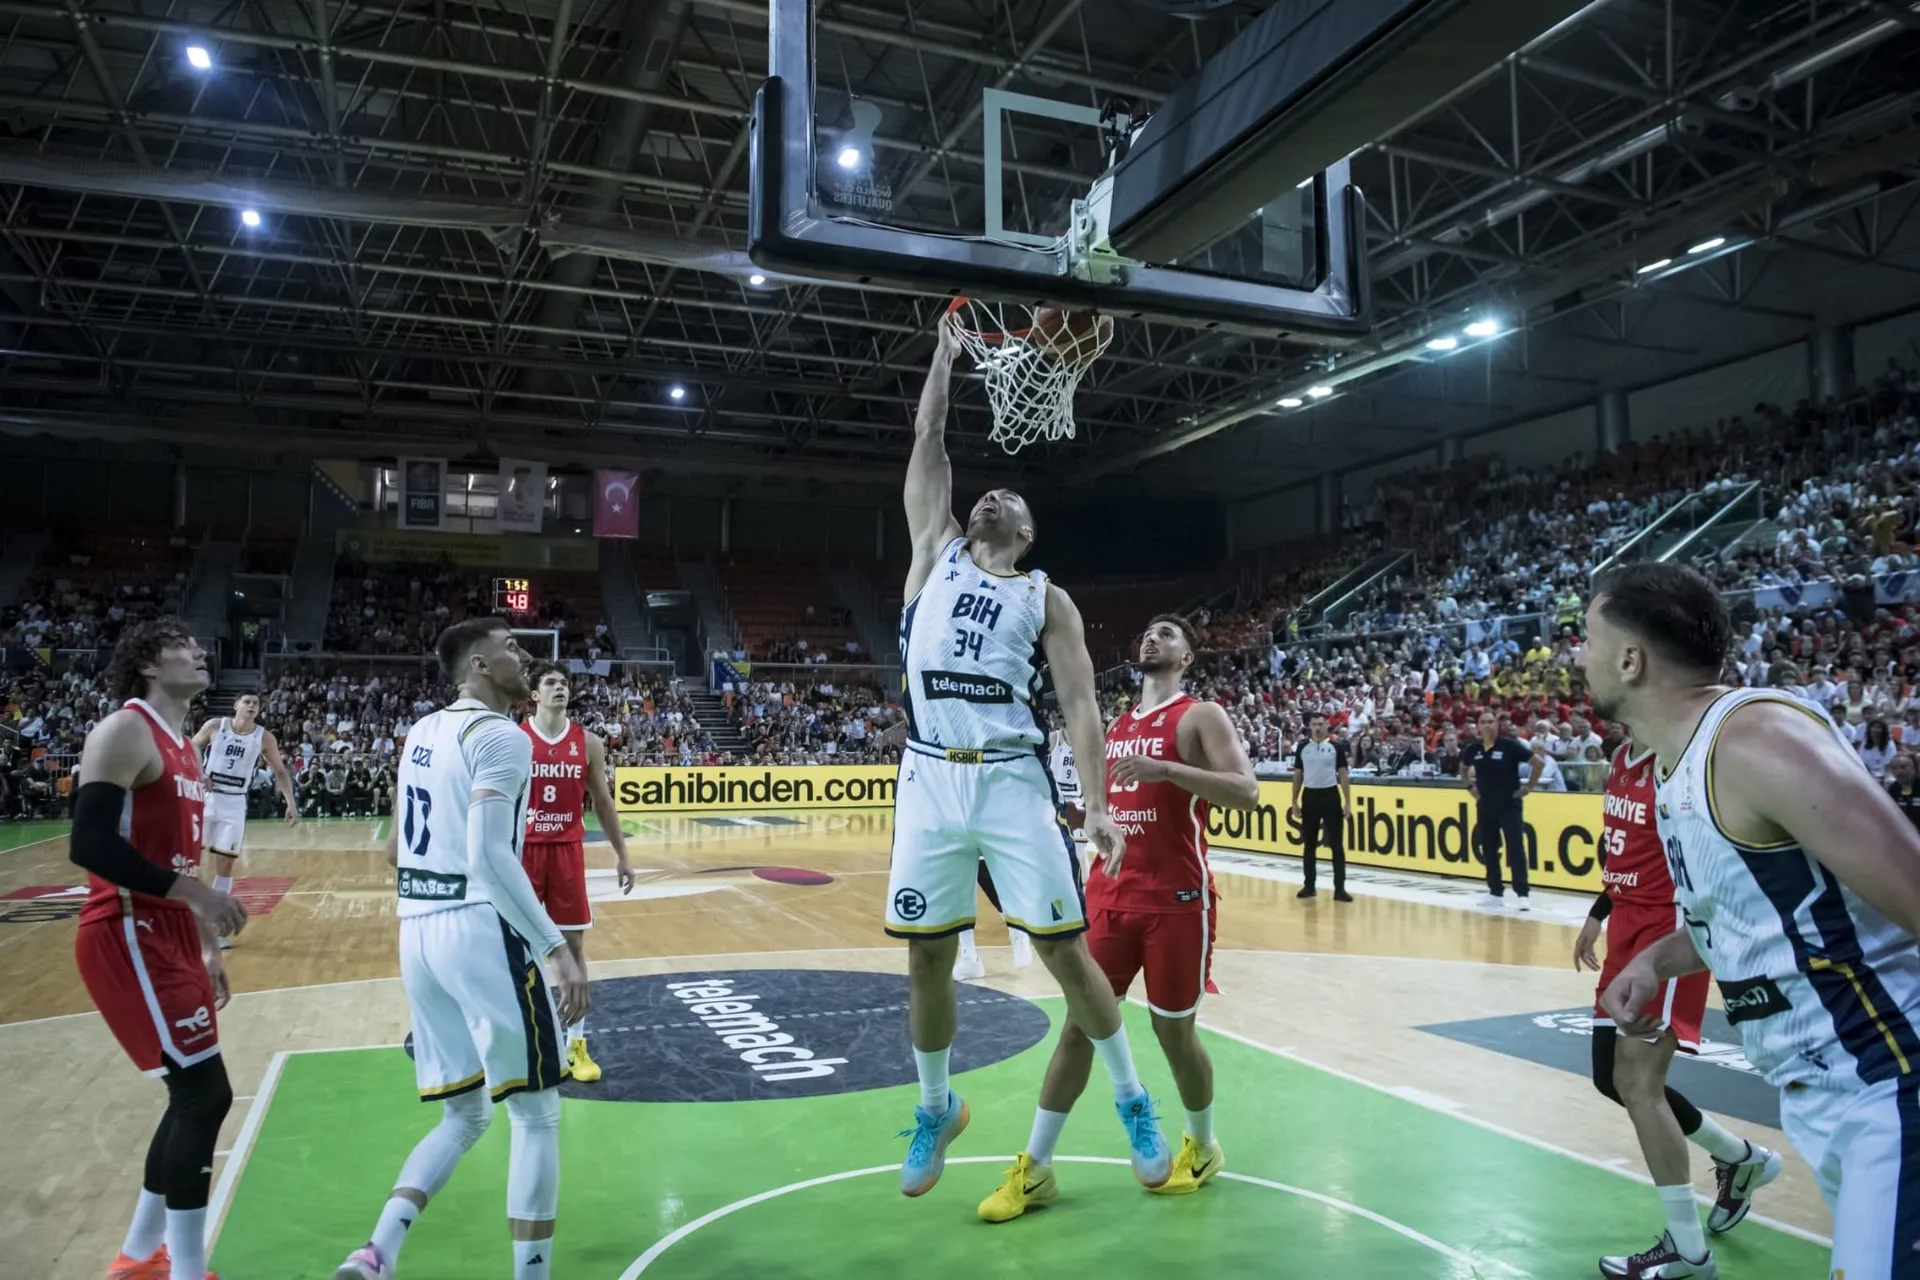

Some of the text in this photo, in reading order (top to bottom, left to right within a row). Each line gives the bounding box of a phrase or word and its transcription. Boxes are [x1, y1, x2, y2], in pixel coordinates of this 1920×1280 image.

[410, 498, 434, 509] FIBA
[951, 593, 1003, 632] BIH
[953, 628, 983, 662] 34
[932, 677, 1006, 696] telemach
[225, 744, 245, 758] BIH
[1106, 735, 1164, 759] ÜRKİYE
[227, 759, 235, 770] 3
[530, 760, 582, 779] ÜRKİYE
[1066, 769, 1072, 779] 9
[543, 785, 556, 803] 8
[620, 772, 897, 805] sahibinden.com
[535, 810, 573, 822] Garanti
[1113, 806, 1157, 822] Garanti
[535, 822, 564, 832] BBVA
[1120, 823, 1145, 836] BVA
[1603, 866, 1638, 887] aranti
[666, 980, 849, 1081] telemach
